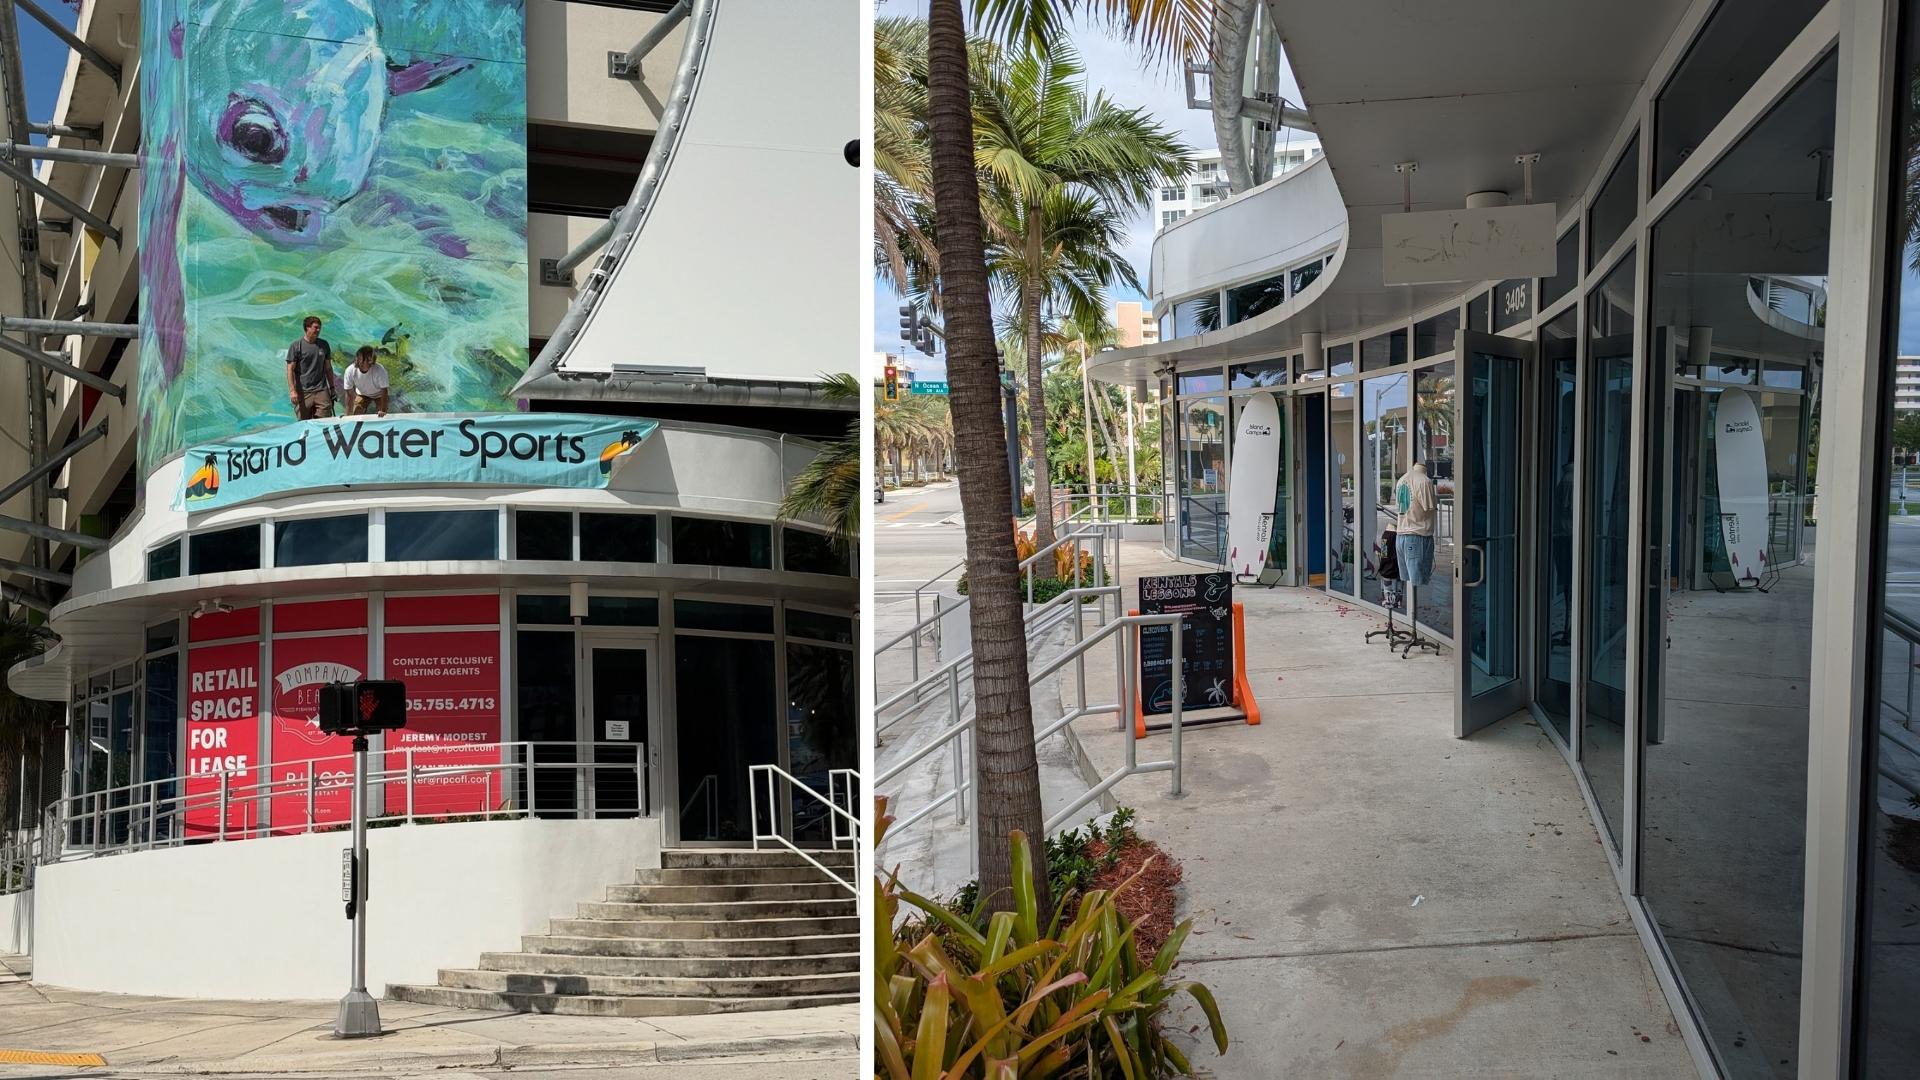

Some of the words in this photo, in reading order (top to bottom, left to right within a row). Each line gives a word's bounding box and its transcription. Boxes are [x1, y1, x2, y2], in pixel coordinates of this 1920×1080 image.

[1505, 284, 1526, 315] 3405
[227, 430, 308, 482] Island
[322, 420, 444, 460] Water
[458, 419, 587, 468] Sports
[1261, 515, 1270, 543] Rentals
[1143, 588, 1196, 600] LESSONS
[393, 657, 439, 666] CONTACT
[440, 656, 494, 665] EXCLUSIVE
[404, 668, 441, 677] LISTING
[442, 667, 481, 676] AGENTS
[192, 667, 258, 693] RETAIL
[286, 665, 349, 687] POMPANO
[298, 689, 320, 705] BEA
[405, 697, 495, 711] 05.755.4713
[191, 696, 253, 722] SPACE
[191, 727, 227, 750] FOR
[400, 733, 441, 742] JEREMY
[443, 732, 488, 741] MODEST
[190, 755, 248, 778] LEASE
[286, 770, 348, 787] RICO
